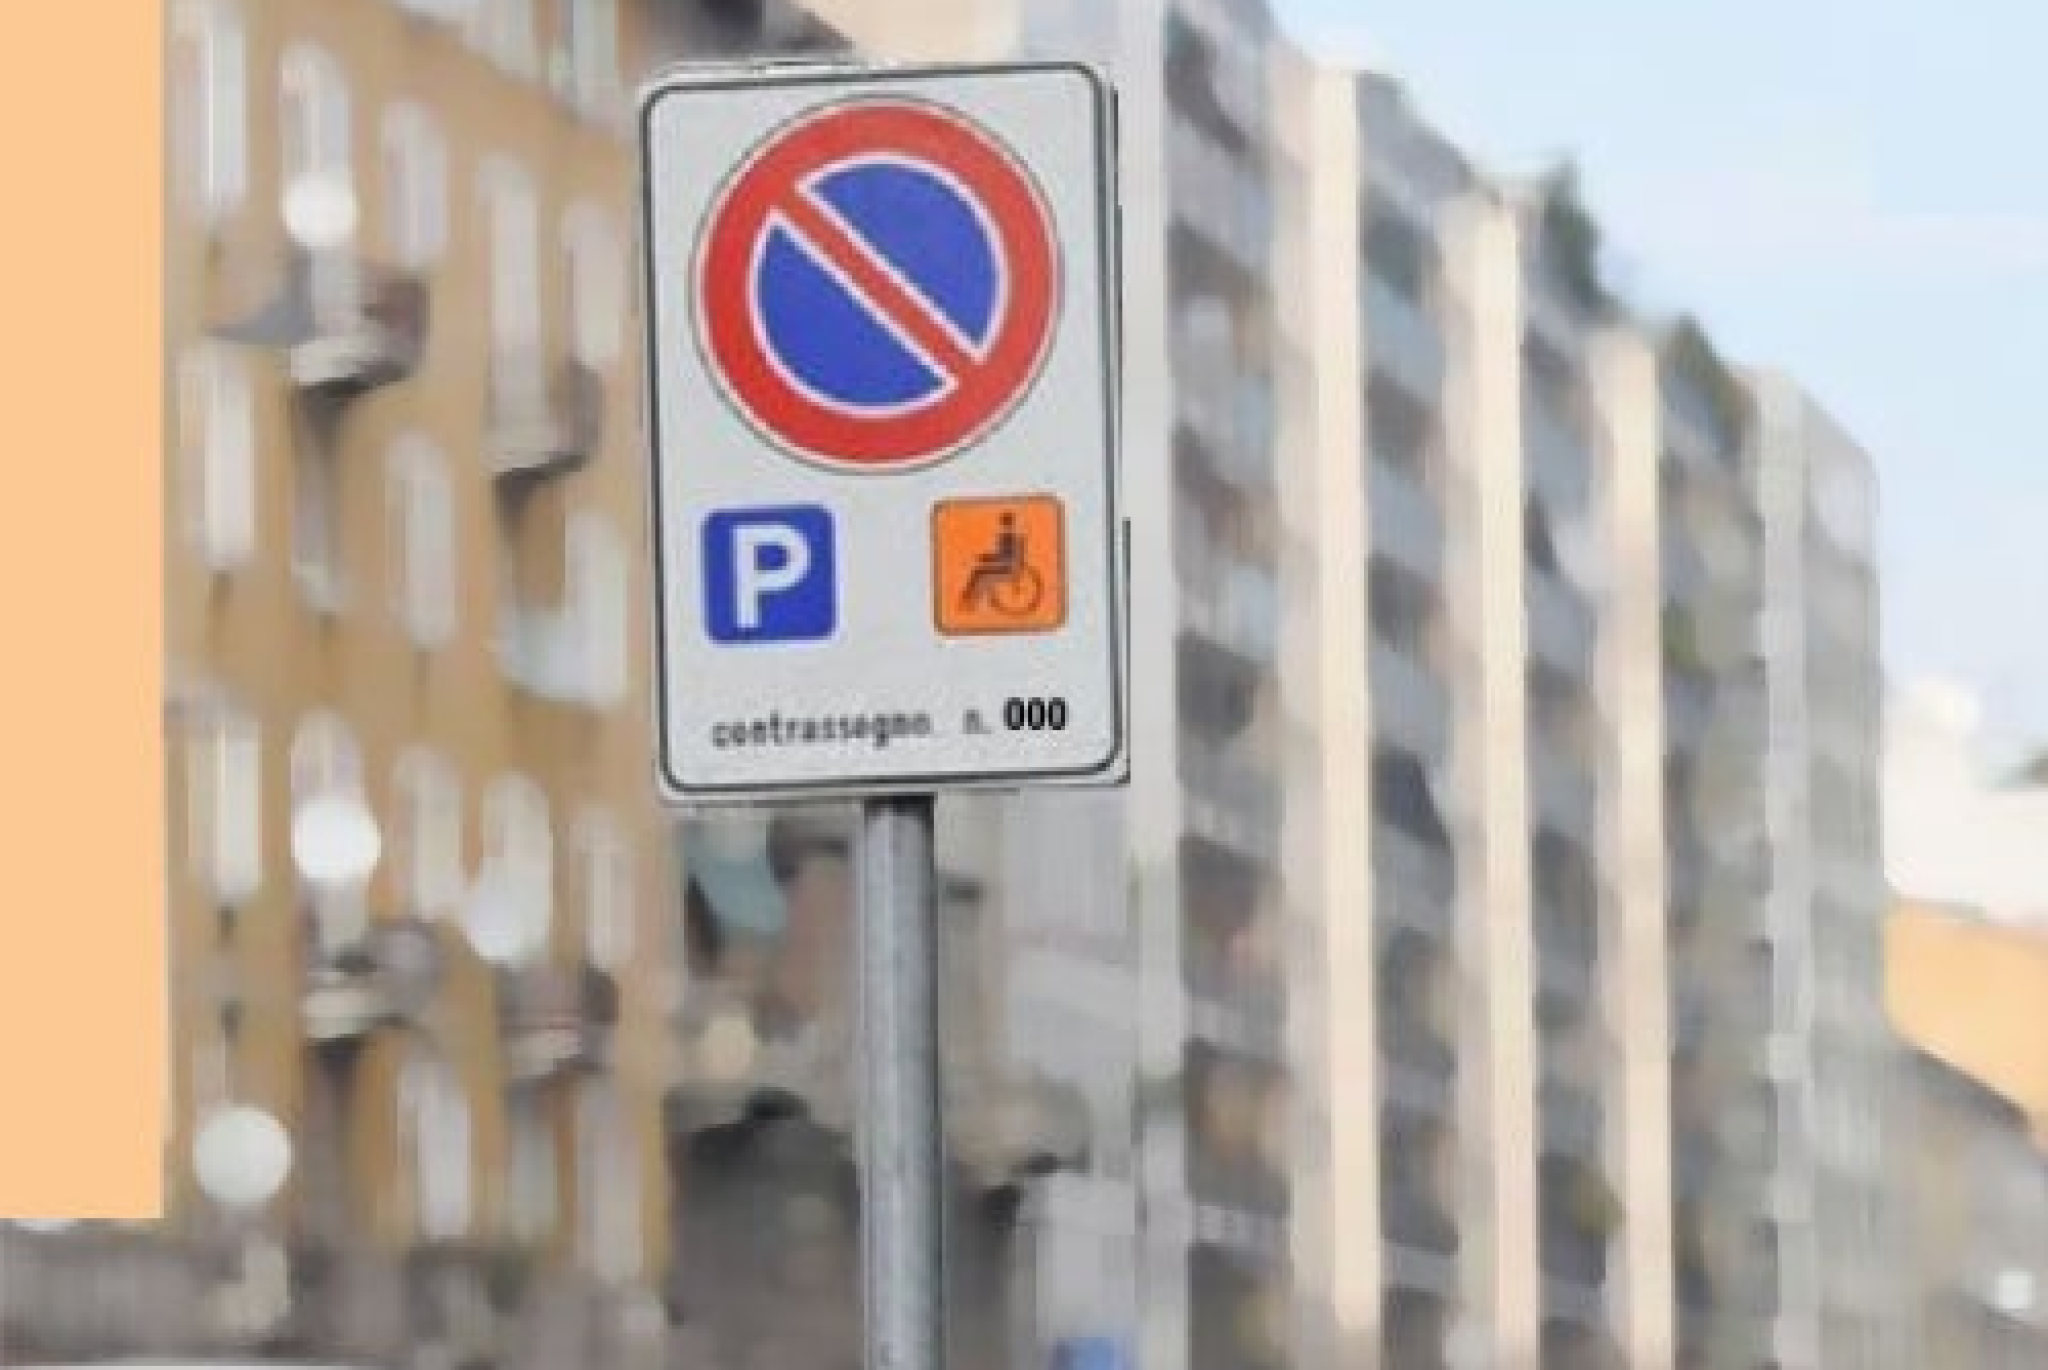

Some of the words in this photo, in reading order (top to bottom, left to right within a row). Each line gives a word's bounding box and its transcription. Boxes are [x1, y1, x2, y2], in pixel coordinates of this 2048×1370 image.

[733, 524, 810, 628] P
[711, 709, 933, 748] contrassegno
[1003, 697, 1069, 731] 000
